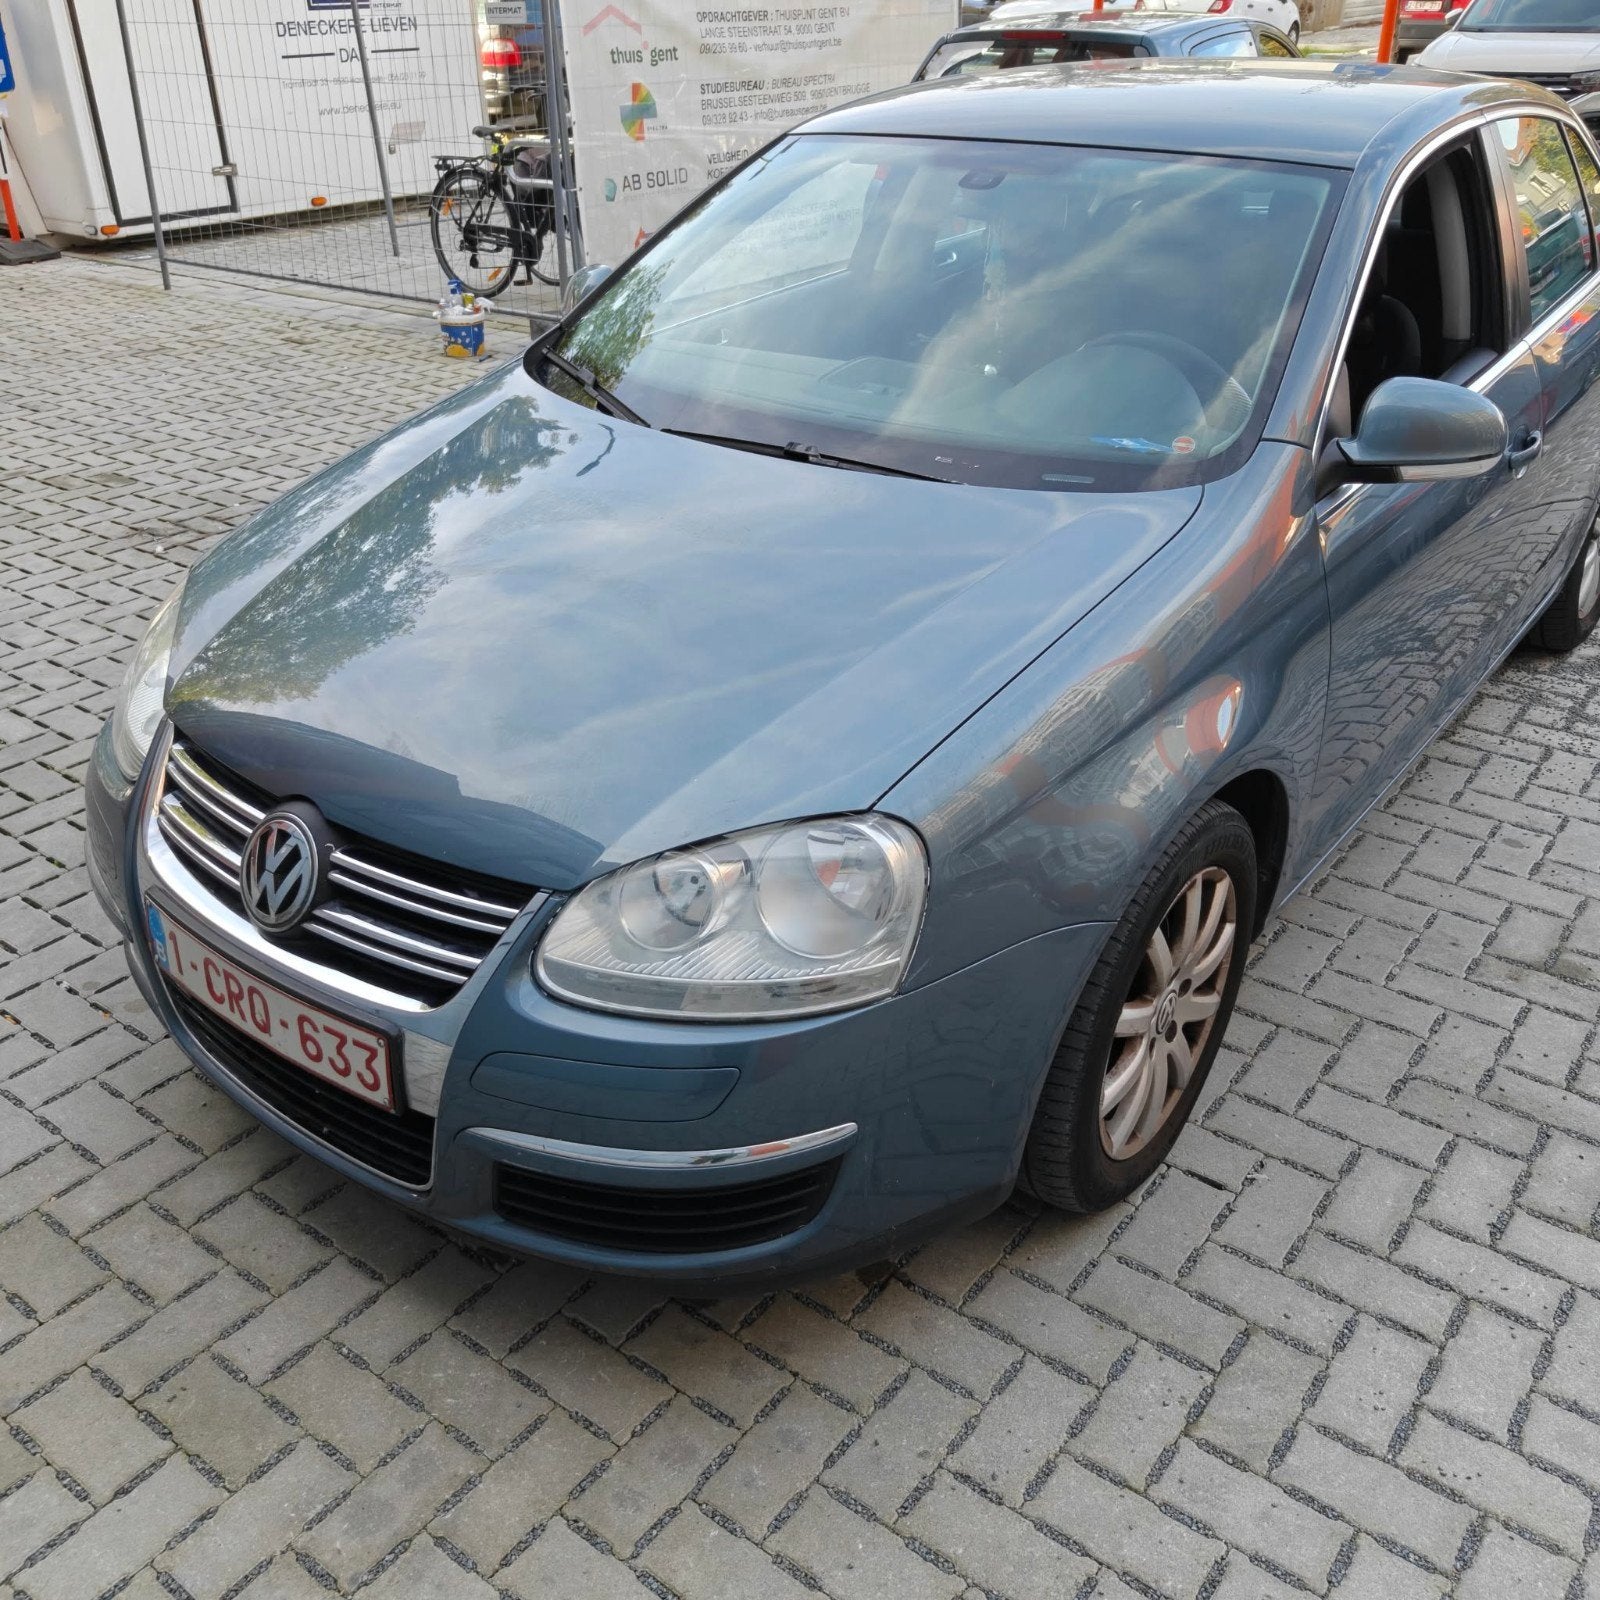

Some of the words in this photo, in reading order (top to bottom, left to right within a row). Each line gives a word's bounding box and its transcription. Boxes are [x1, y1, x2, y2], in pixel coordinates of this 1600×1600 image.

[696, 10, 768, 22] OPDRACHTGEVER
[818, 8, 838, 19] GENT
[370, 17, 417, 32] LIEVEN
[700, 27, 726, 38] LANGE
[727, 25, 782, 38] STEENSTRAAT
[814, 22, 835, 33] GENT
[339, 48, 369, 63] DA
[610, 46, 643, 64] thuis
[650, 46, 678, 66] gent
[700, 80, 765, 94] STUDIEBUREAU
[771, 77, 801, 90] BUREAU
[701, 92, 792, 110] BRUSSELSESTEENWEG
[622, 174, 641, 192] AB
[647, 167, 688, 188] SOLID
